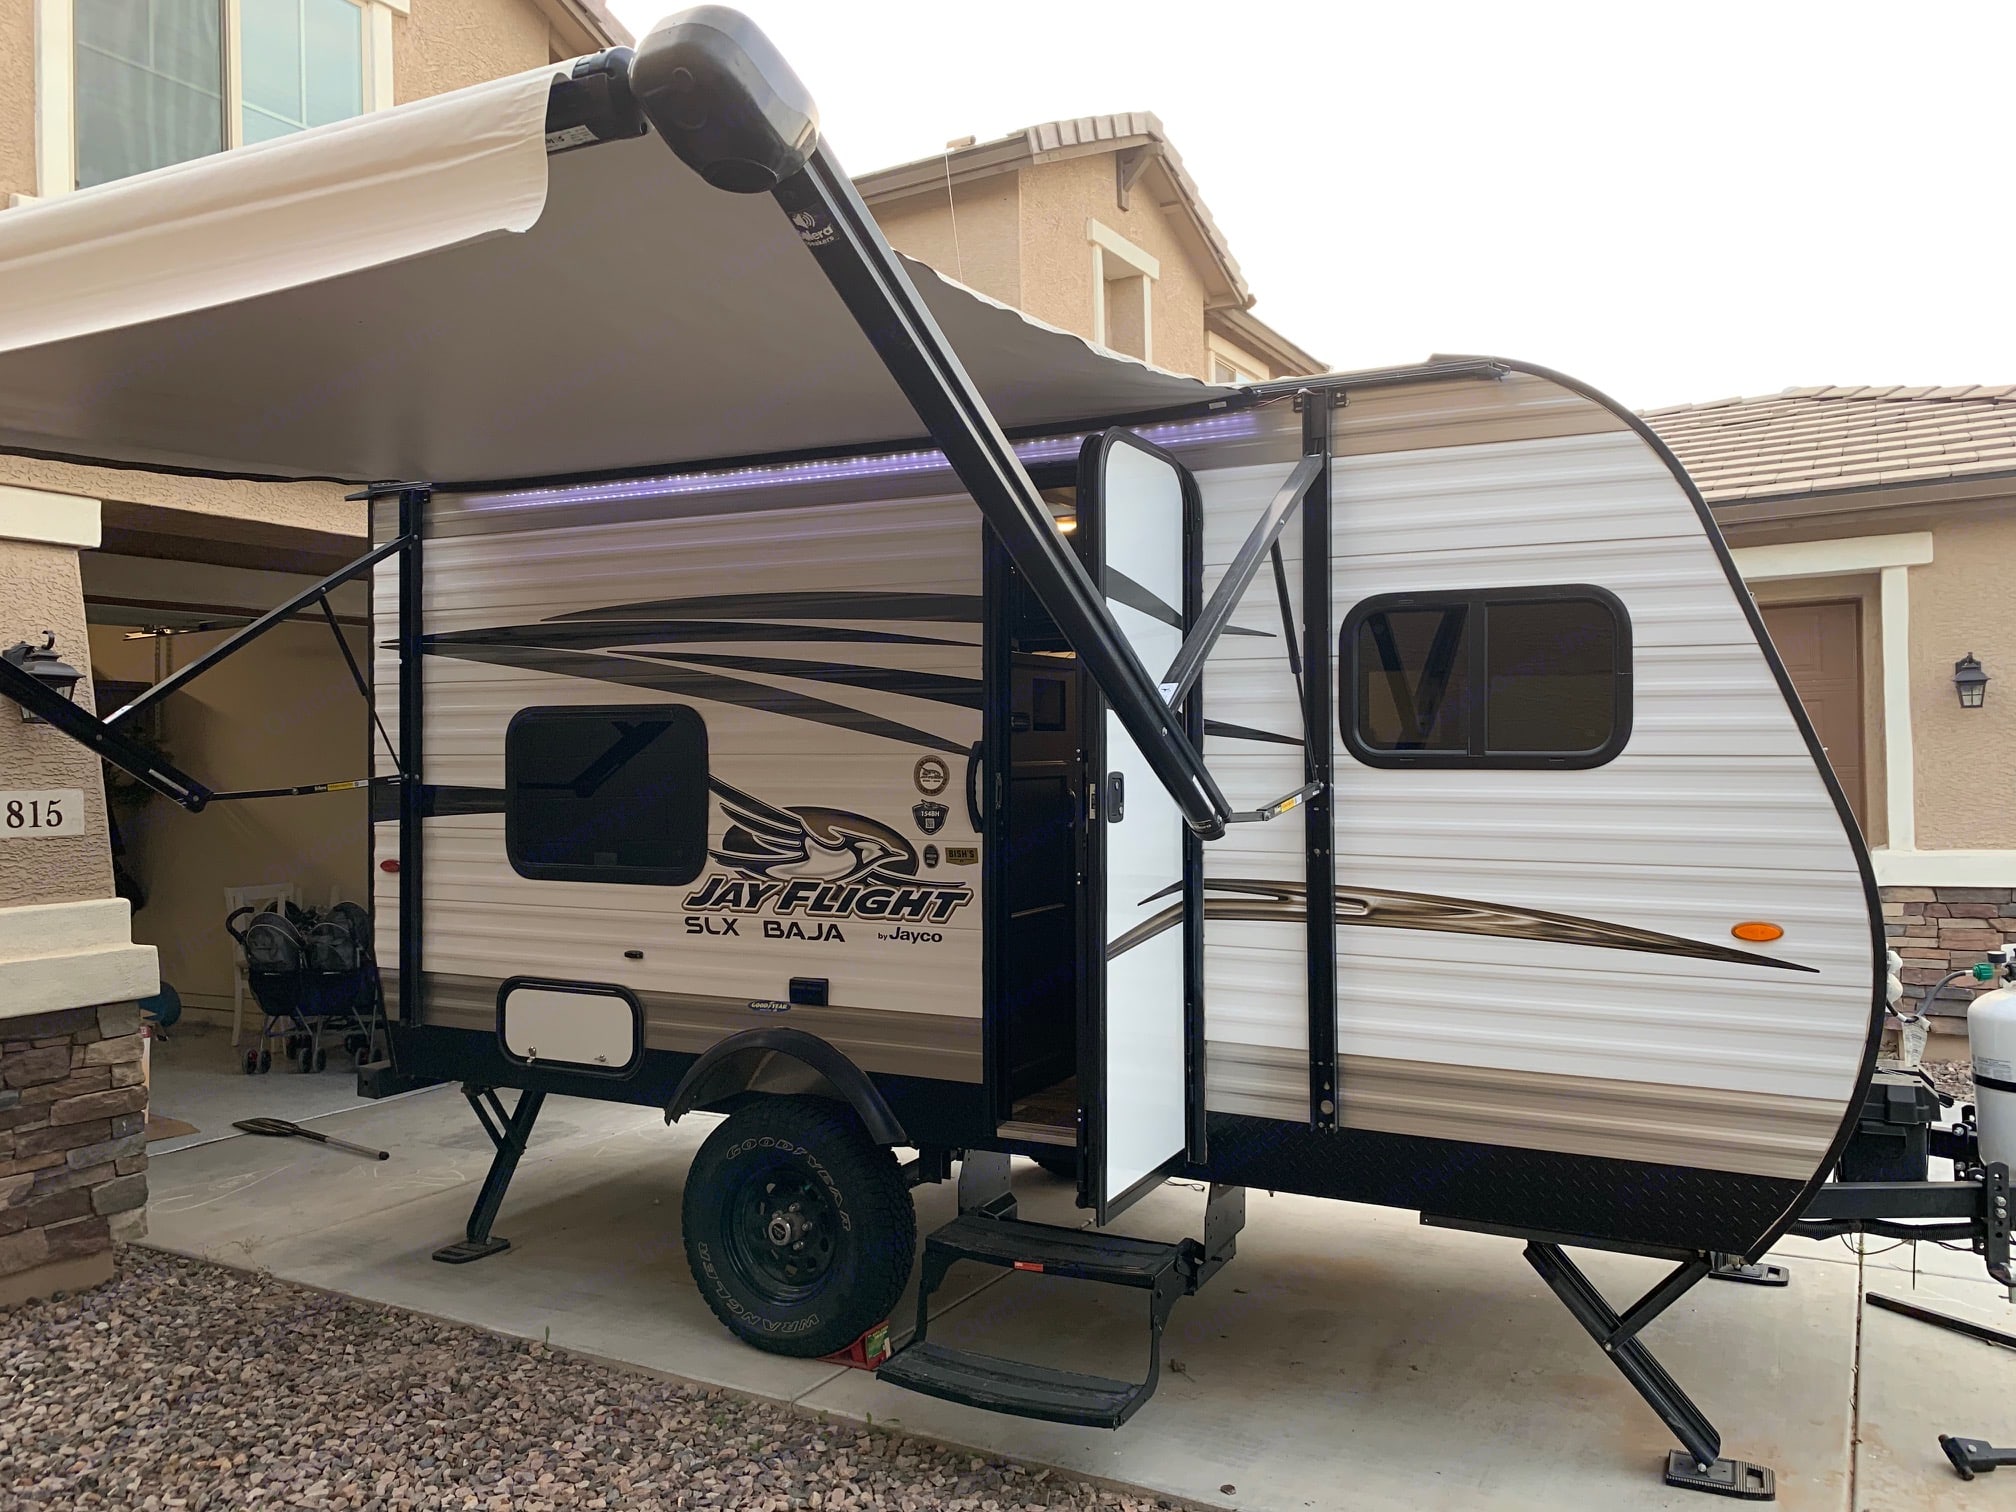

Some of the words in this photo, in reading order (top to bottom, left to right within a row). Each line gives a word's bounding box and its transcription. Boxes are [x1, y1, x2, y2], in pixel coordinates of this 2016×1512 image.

[7, 800, 63, 828] 815
[949, 850, 974, 858] BISH'S
[682, 874, 780, 912] JAY
[776, 878, 973, 922] FLIGHT
[684, 917, 741, 937] SLX
[763, 920, 846, 943] BAJA
[877, 932, 888, 942] by
[889, 926, 943, 945] Jayco
[727, 1137, 851, 1231] GOODYEAR
[697, 1240, 820, 1333] WRANGLER
